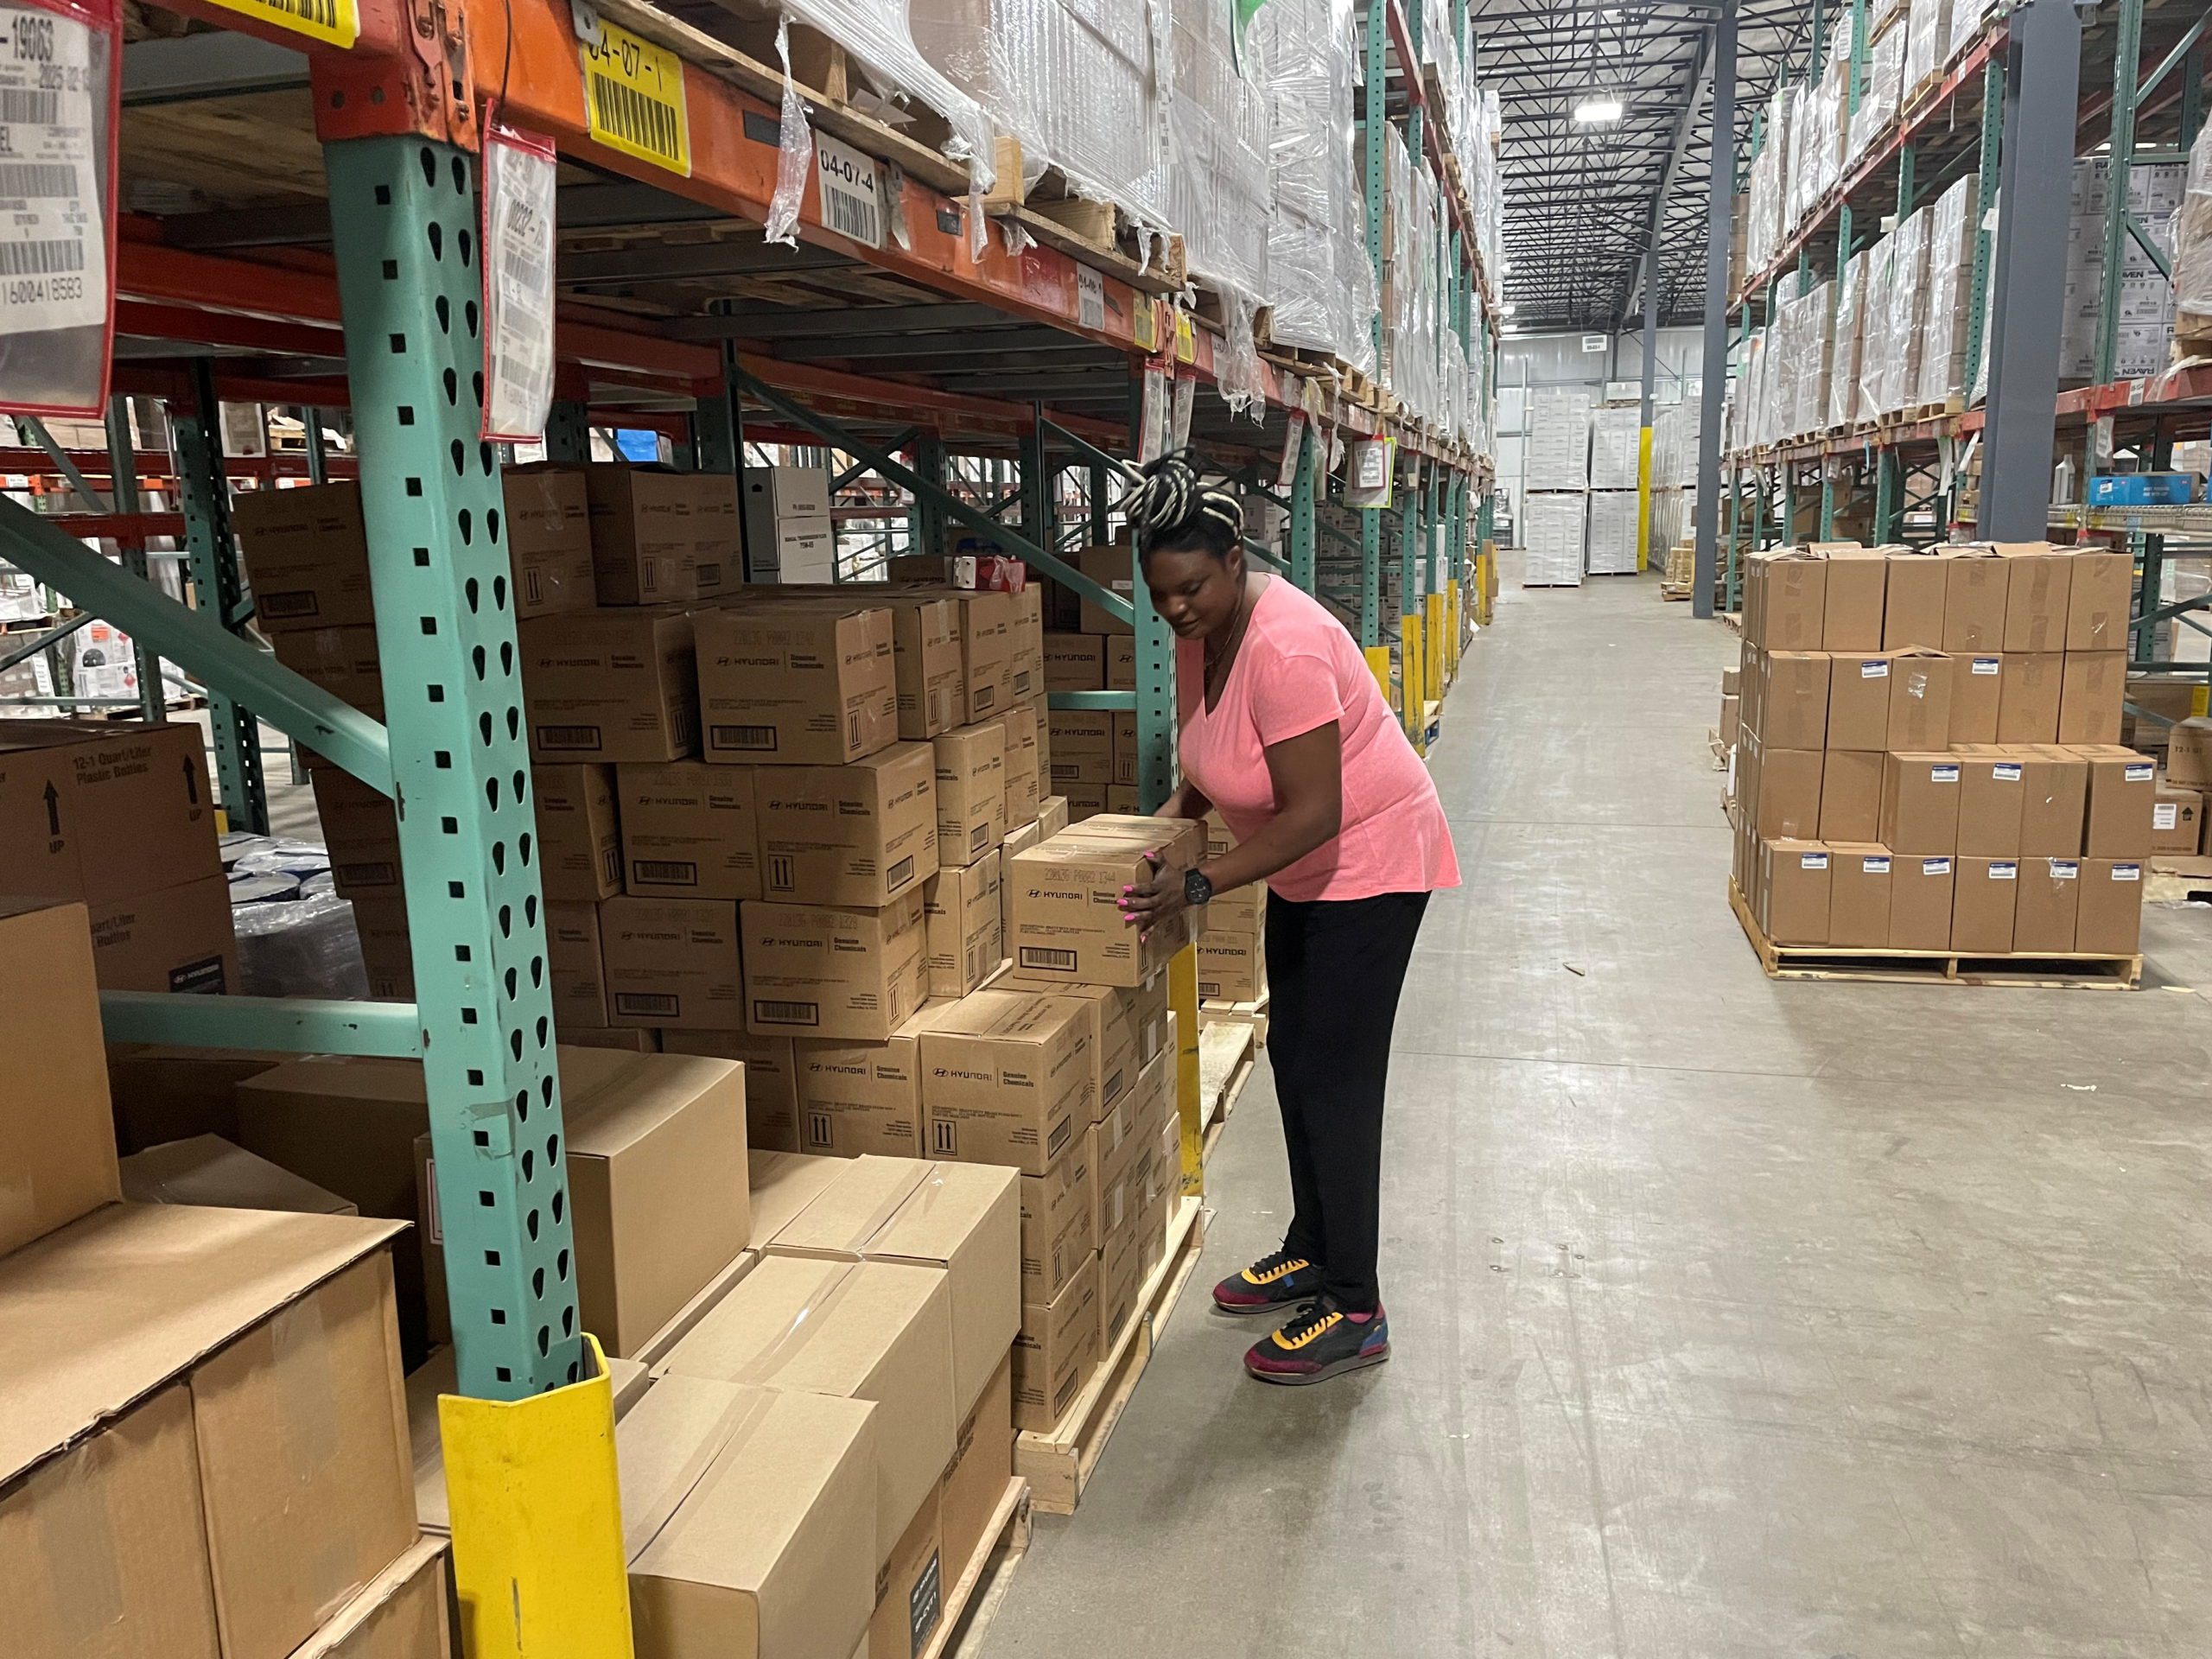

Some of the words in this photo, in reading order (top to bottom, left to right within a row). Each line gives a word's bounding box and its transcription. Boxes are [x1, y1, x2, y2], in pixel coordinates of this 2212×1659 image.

[734, 658, 779, 666] HYUNDAI
[1054, 653, 1096, 662] HYUNDAI
[1065, 728, 1105, 737] HYUNDAI
[655, 798, 698, 806] HYUNDAI
[785, 803, 829, 811] HYUNDAI
[1044, 891, 1083, 899] HYUNDAI
[779, 938, 823, 948] HYUNDAI
[1206, 947, 1247, 956] HYUNDAI
[825, 1066, 866, 1075] HYUNDAI
[1002, 1071, 1027, 1079] Genuine
[876, 1072, 908, 1081] Chemicals
[950, 1070, 993, 1082] HYUNDAI
[1002, 1078, 1034, 1088] Chemicals
